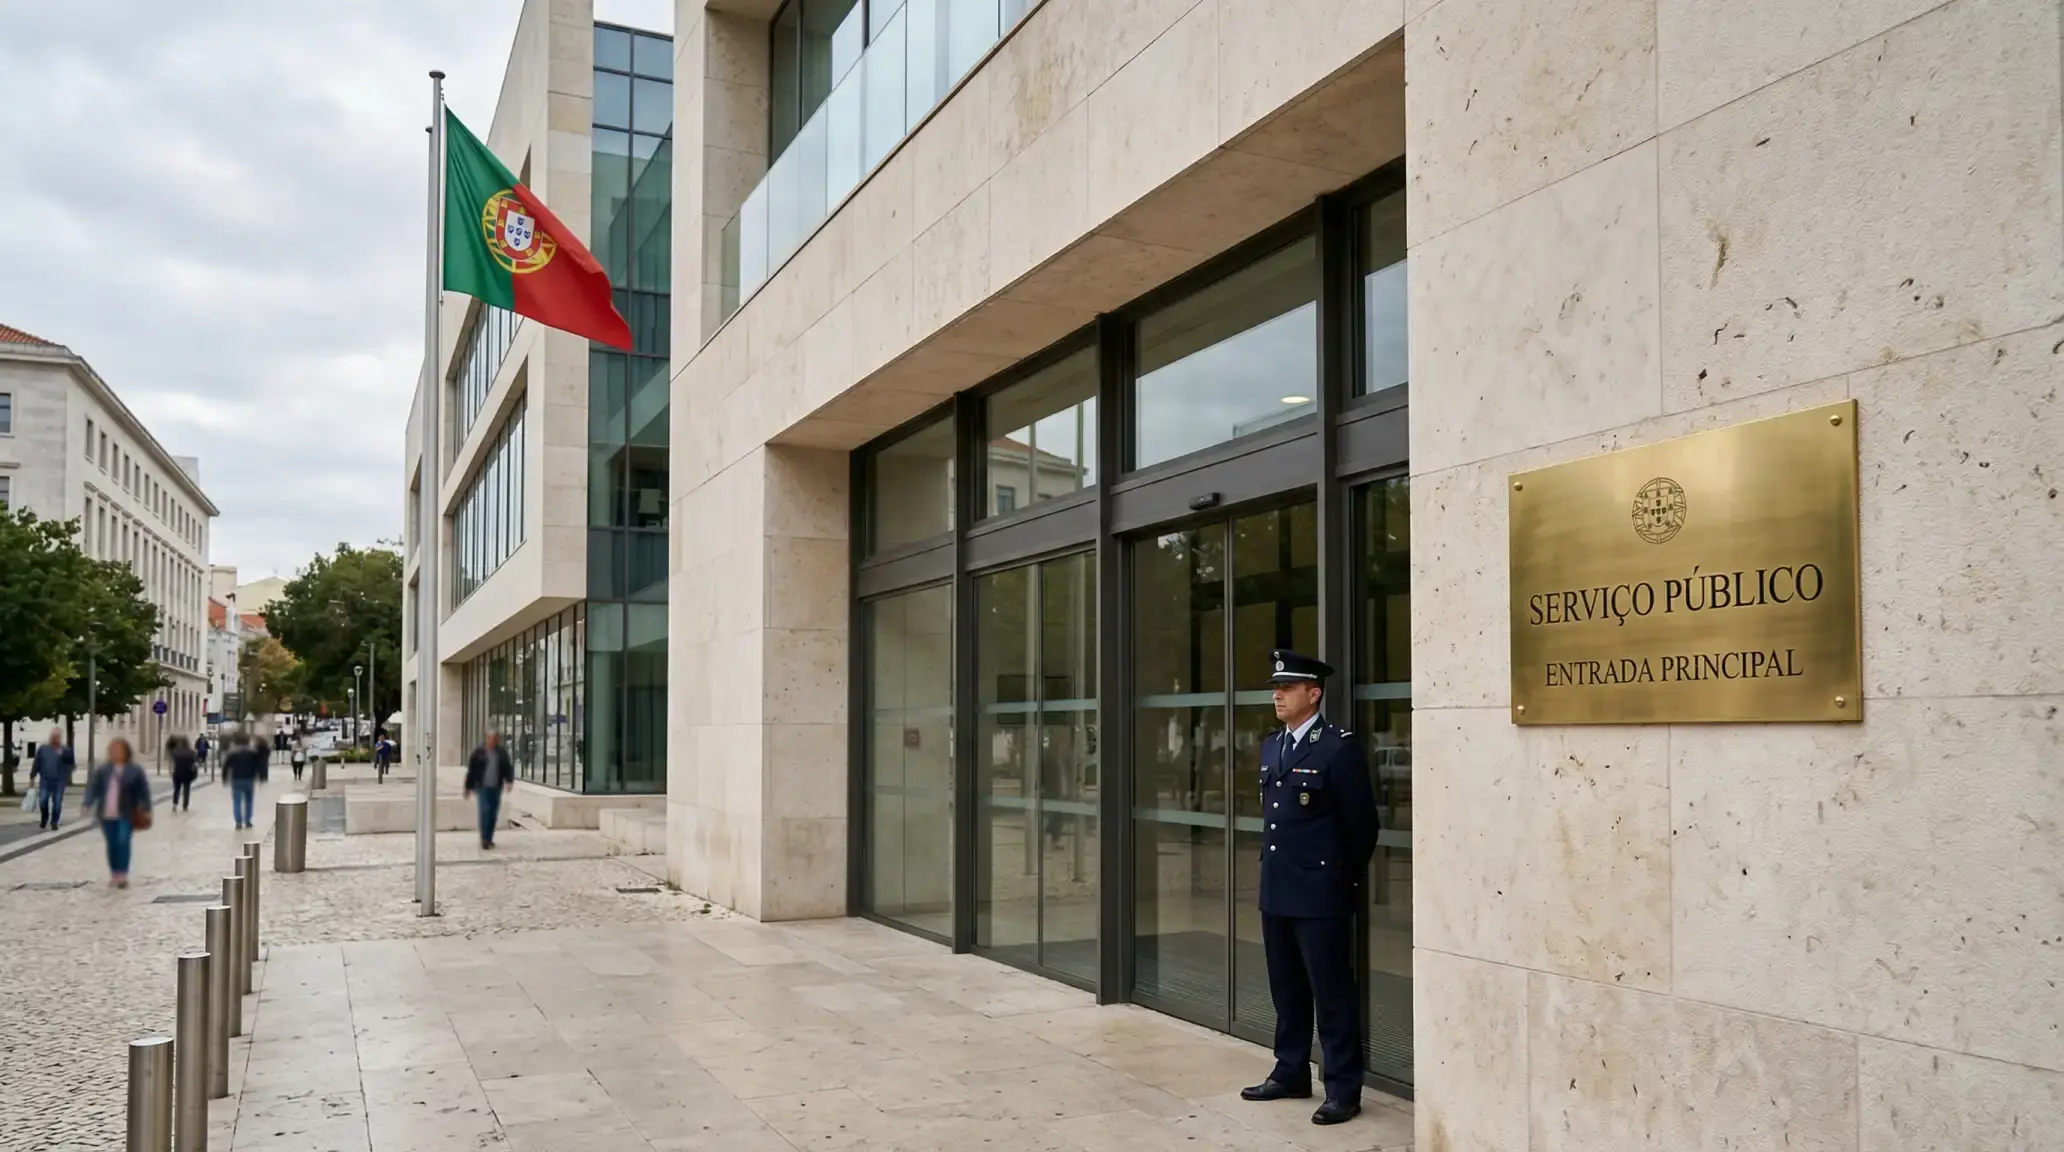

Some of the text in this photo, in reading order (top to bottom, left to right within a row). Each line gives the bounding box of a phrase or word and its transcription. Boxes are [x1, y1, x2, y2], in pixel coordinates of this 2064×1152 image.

[1530, 564, 1824, 626] SERVIÇO PÚBLICO
[1545, 649, 1803, 687] ENTRADA PRINCIPAL
